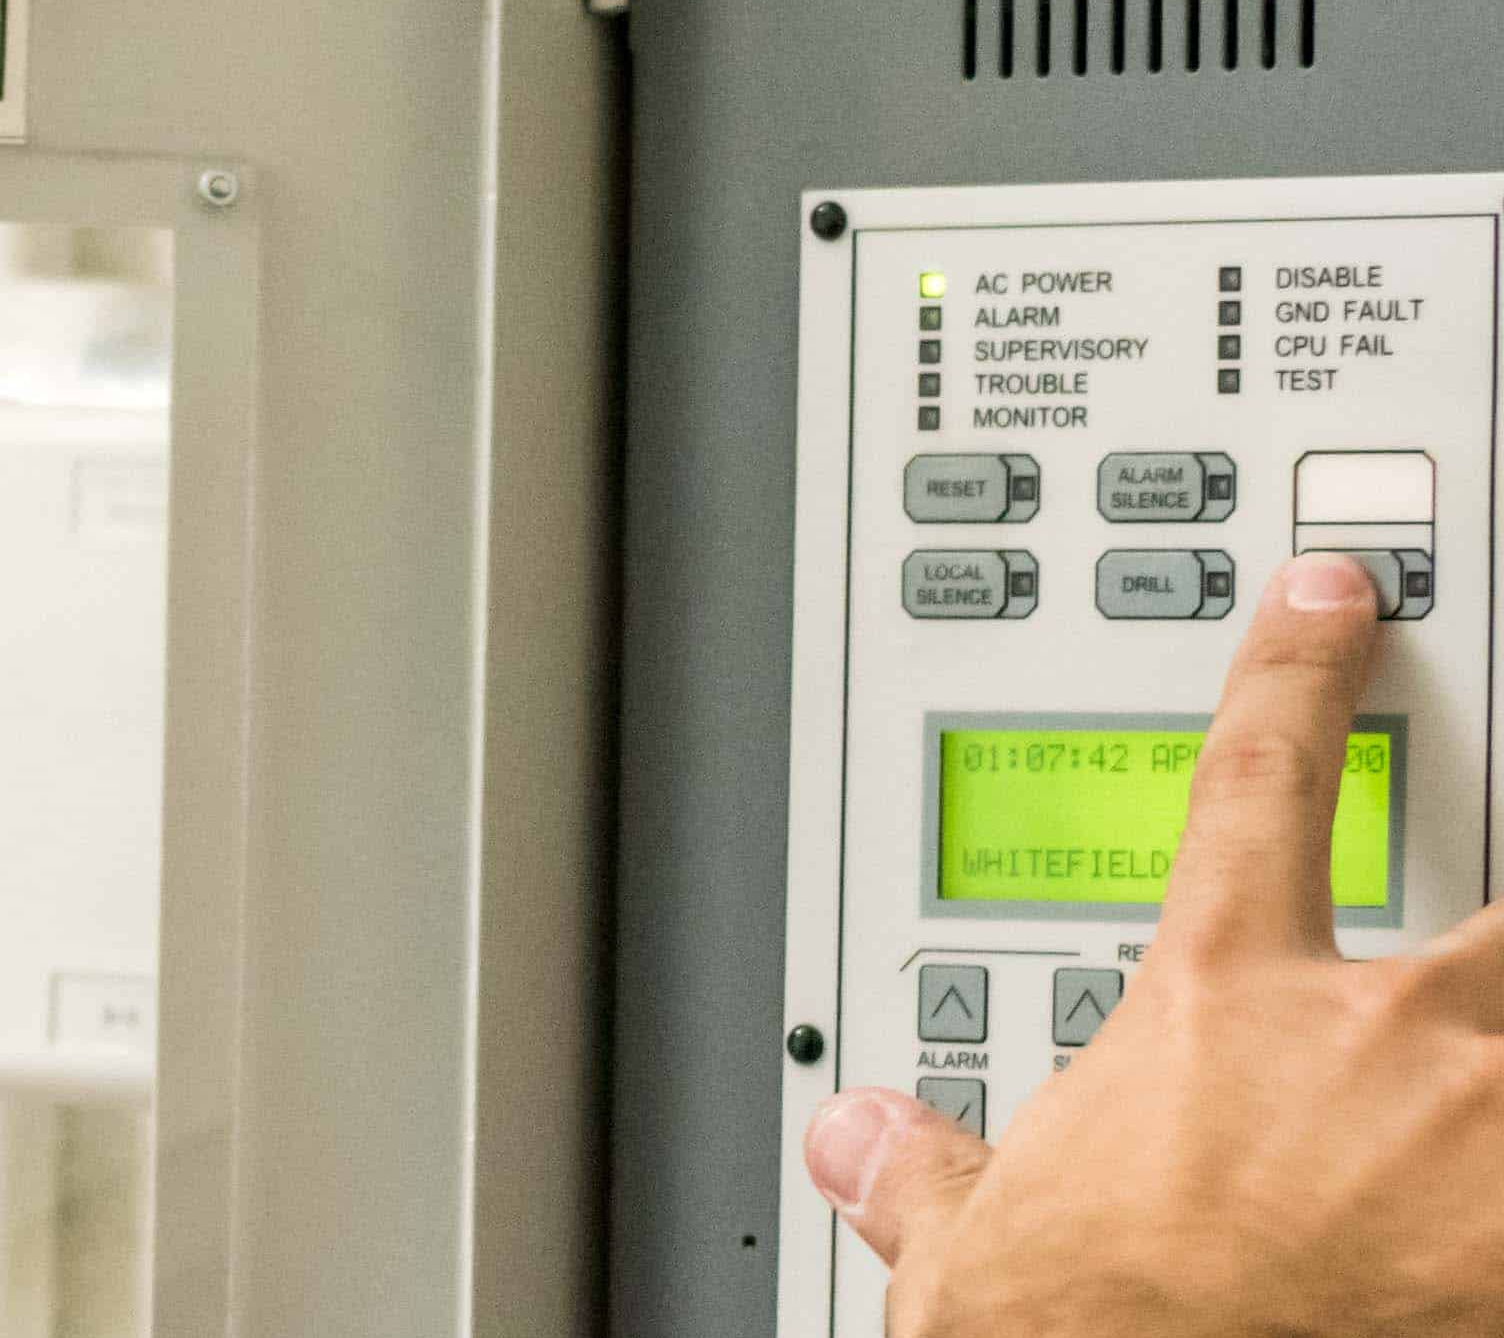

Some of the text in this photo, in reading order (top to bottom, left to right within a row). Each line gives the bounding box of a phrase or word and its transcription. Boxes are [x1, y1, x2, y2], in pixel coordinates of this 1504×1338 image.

[974, 271, 1114, 295] AC POWER
[1275, 264, 1384, 290] DISABLE
[974, 306, 1061, 329] ALARM
[1275, 298, 1425, 324] GND FAULT
[974, 337, 1150, 362] SUPERVISORY
[1274, 333, 1395, 358] CPU FAIL
[974, 372, 1089, 396] TROUBLE
[1273, 368, 1339, 392] TEST
[972, 405, 1088, 429] MONITOR
[1118, 465, 1184, 485] ALARM
[926, 478, 989, 498] RESET
[1110, 490, 1191, 510] SILENCE
[923, 563, 985, 582] LOCAL
[916, 587, 993, 607] SILENCE
[1121, 575, 1175, 595] DRILL
[963, 743, 1130, 774] 01:07:42
[1151, 743, 1202, 774] AP
[962, 848, 1170, 879] WHITEFIELD
[1117, 943, 1151, 963] RE
[916, 1050, 990, 1071] ALARM
